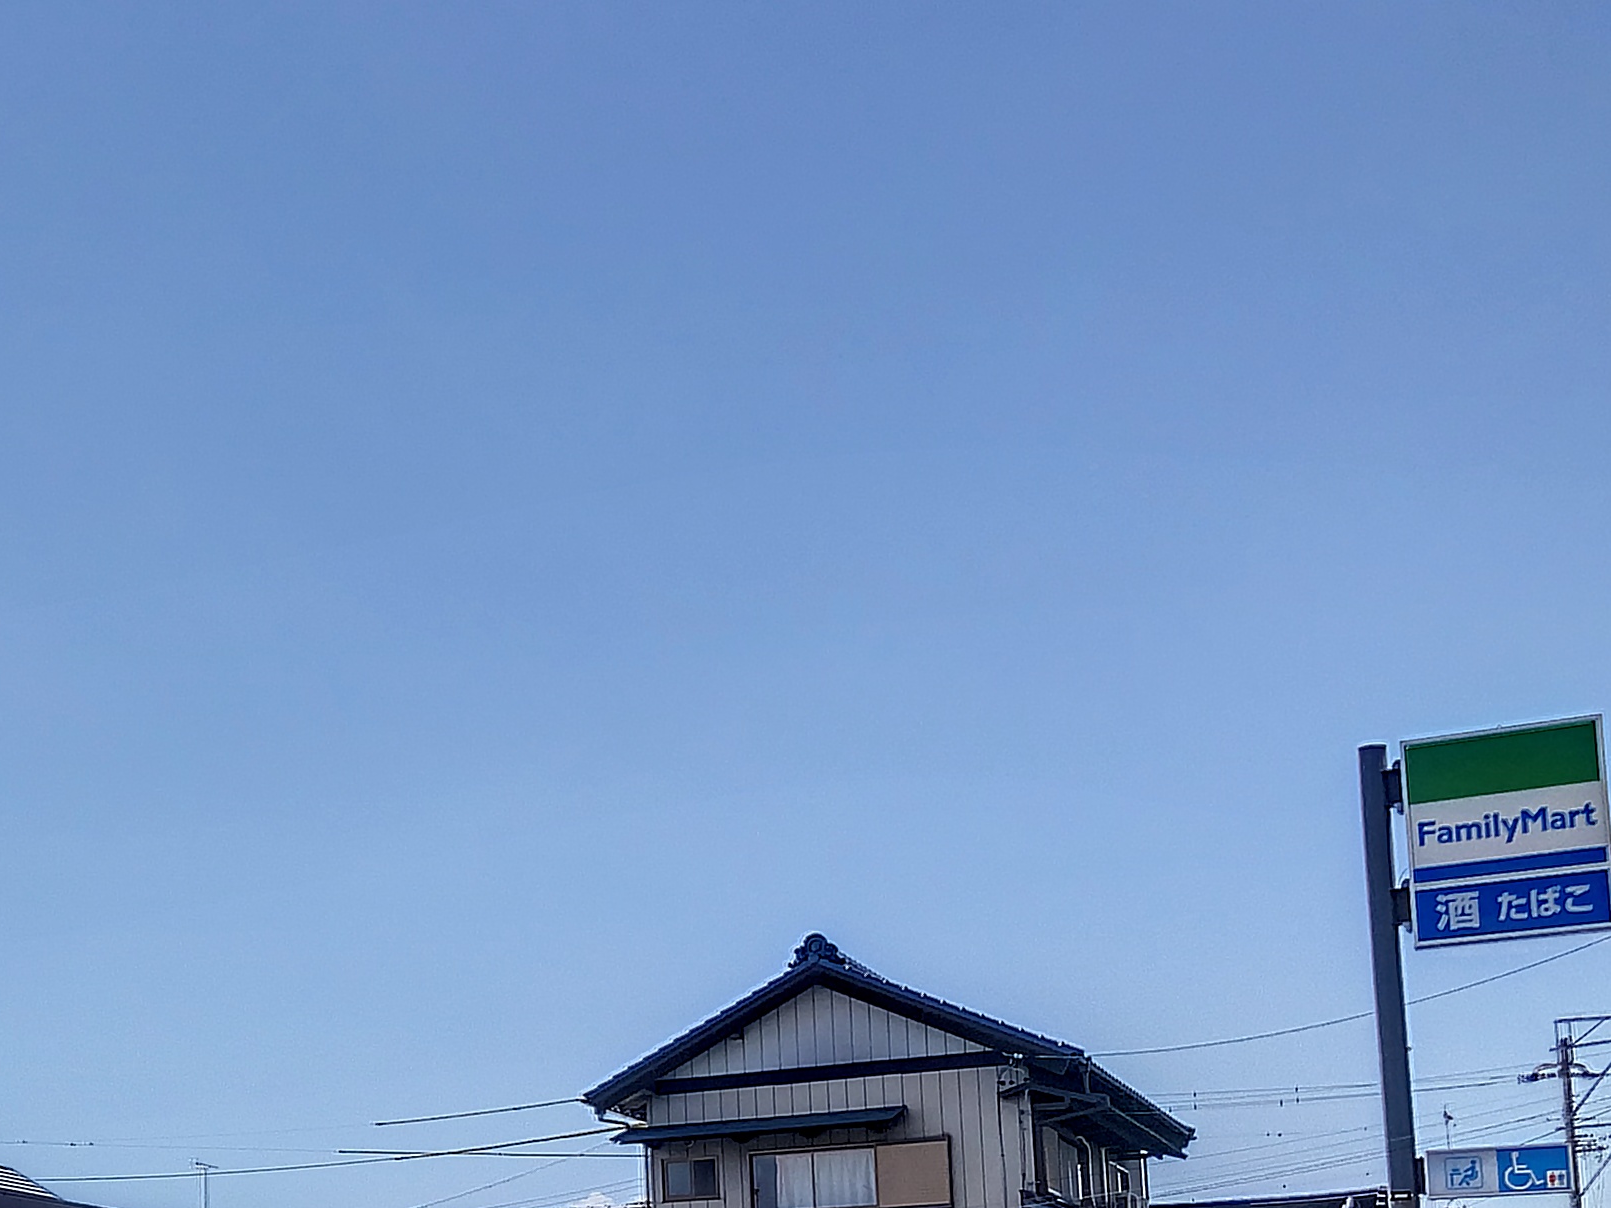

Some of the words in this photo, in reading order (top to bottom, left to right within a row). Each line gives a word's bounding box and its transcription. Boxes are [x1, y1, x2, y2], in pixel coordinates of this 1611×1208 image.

[1417, 802, 1597, 846] FamilyMart
[1436, 890, 1480, 930] 酒
[1496, 884, 1593, 921] たばこ
